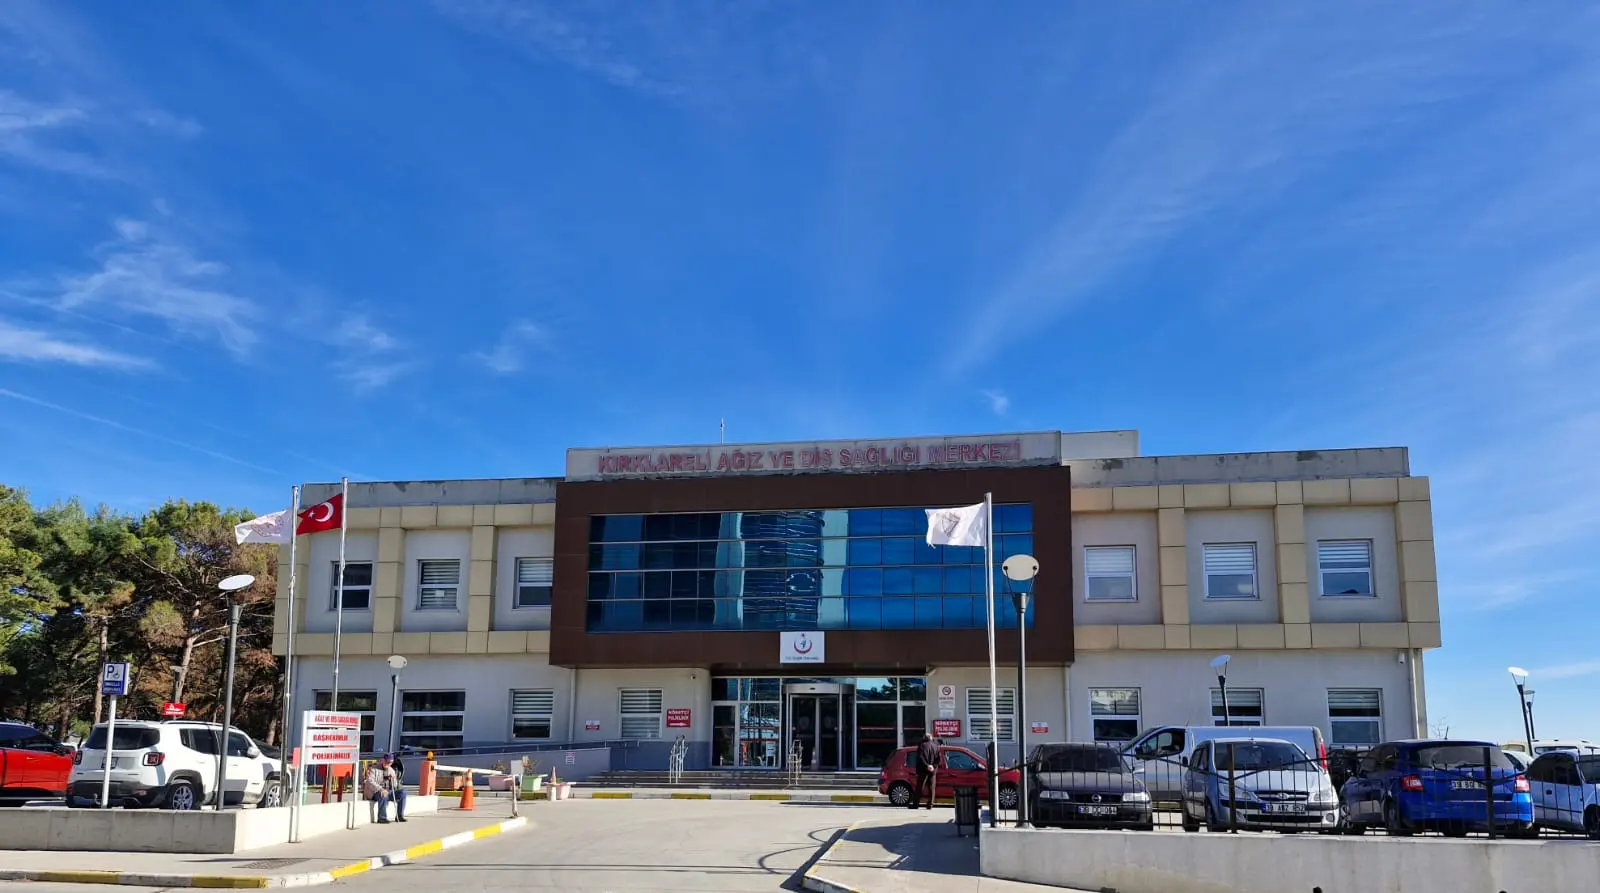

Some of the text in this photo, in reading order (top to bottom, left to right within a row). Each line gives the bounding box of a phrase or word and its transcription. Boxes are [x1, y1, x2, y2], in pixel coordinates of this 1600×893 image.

[598, 448, 712, 473] KIRKLARELİ
[717, 448, 764, 470] AĞIZ
[769, 450, 793, 469] VE
[927, 438, 1021, 464] MERKEZİ
[107, 665, 114, 678] P
